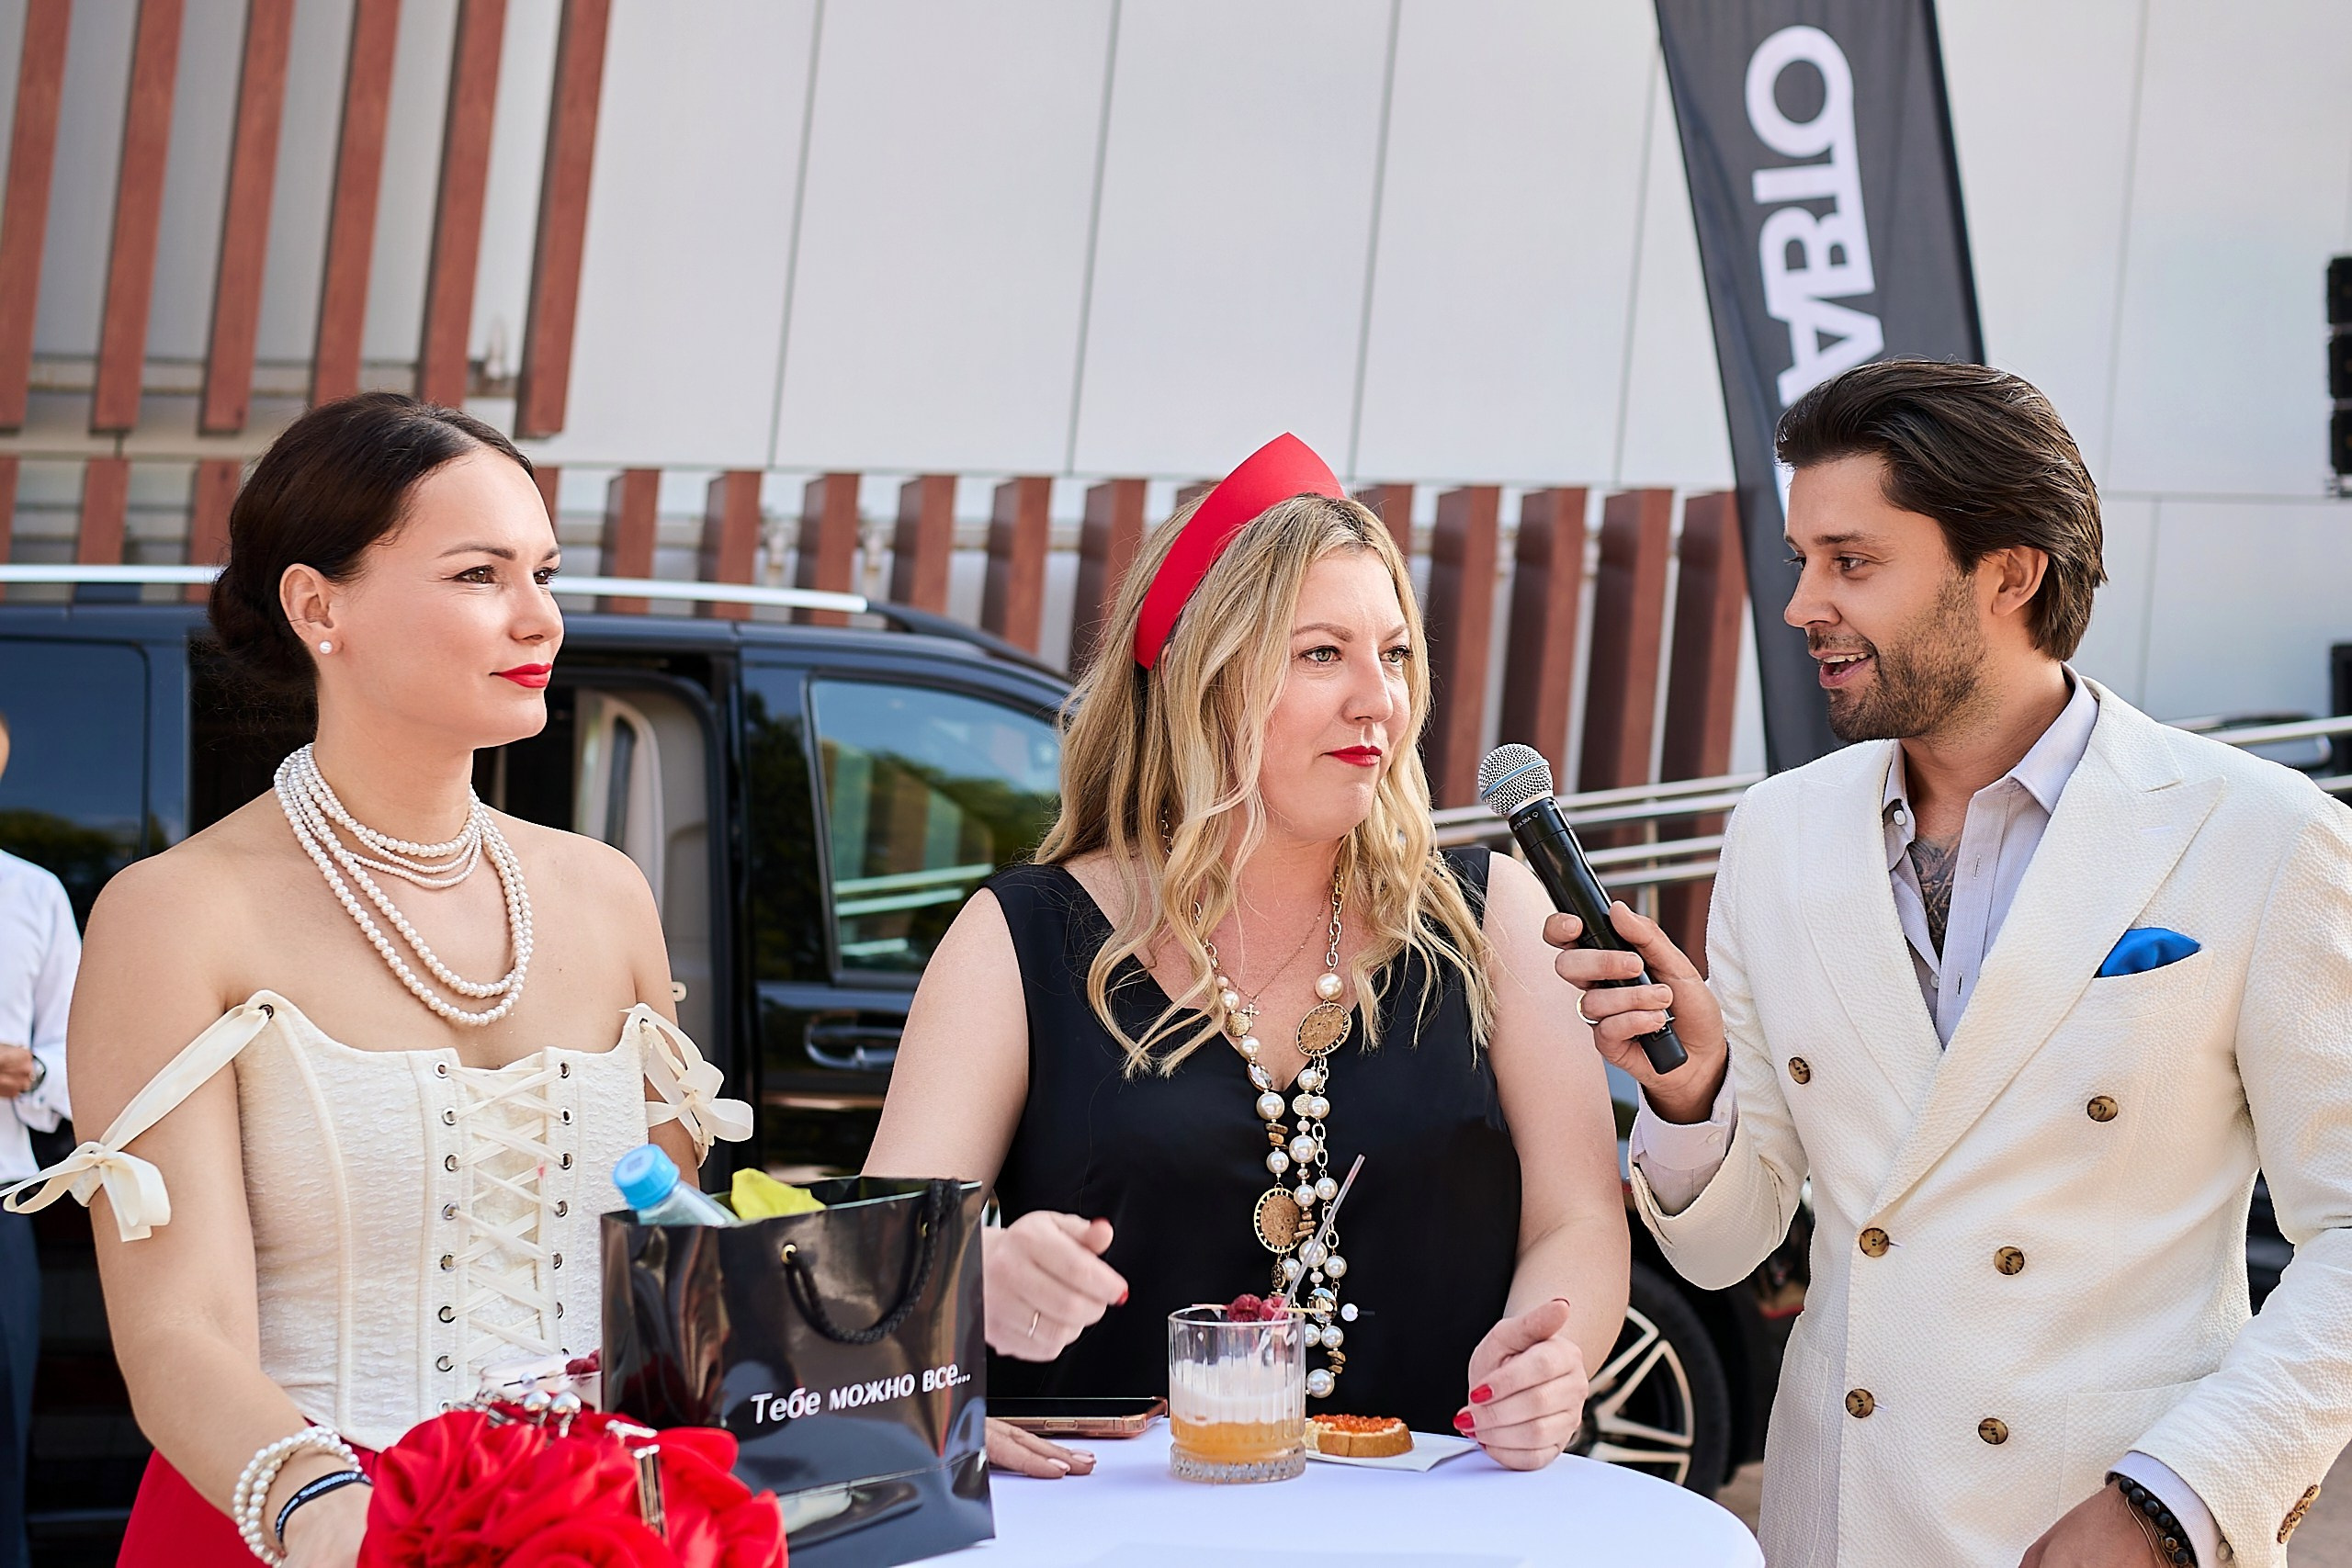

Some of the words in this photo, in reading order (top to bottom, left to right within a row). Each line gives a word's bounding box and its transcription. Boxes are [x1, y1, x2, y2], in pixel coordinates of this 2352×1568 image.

[750, 1387, 821, 1424] Тебе
[829, 1373, 916, 1411] можно
[922, 1363, 971, 1393] все...
